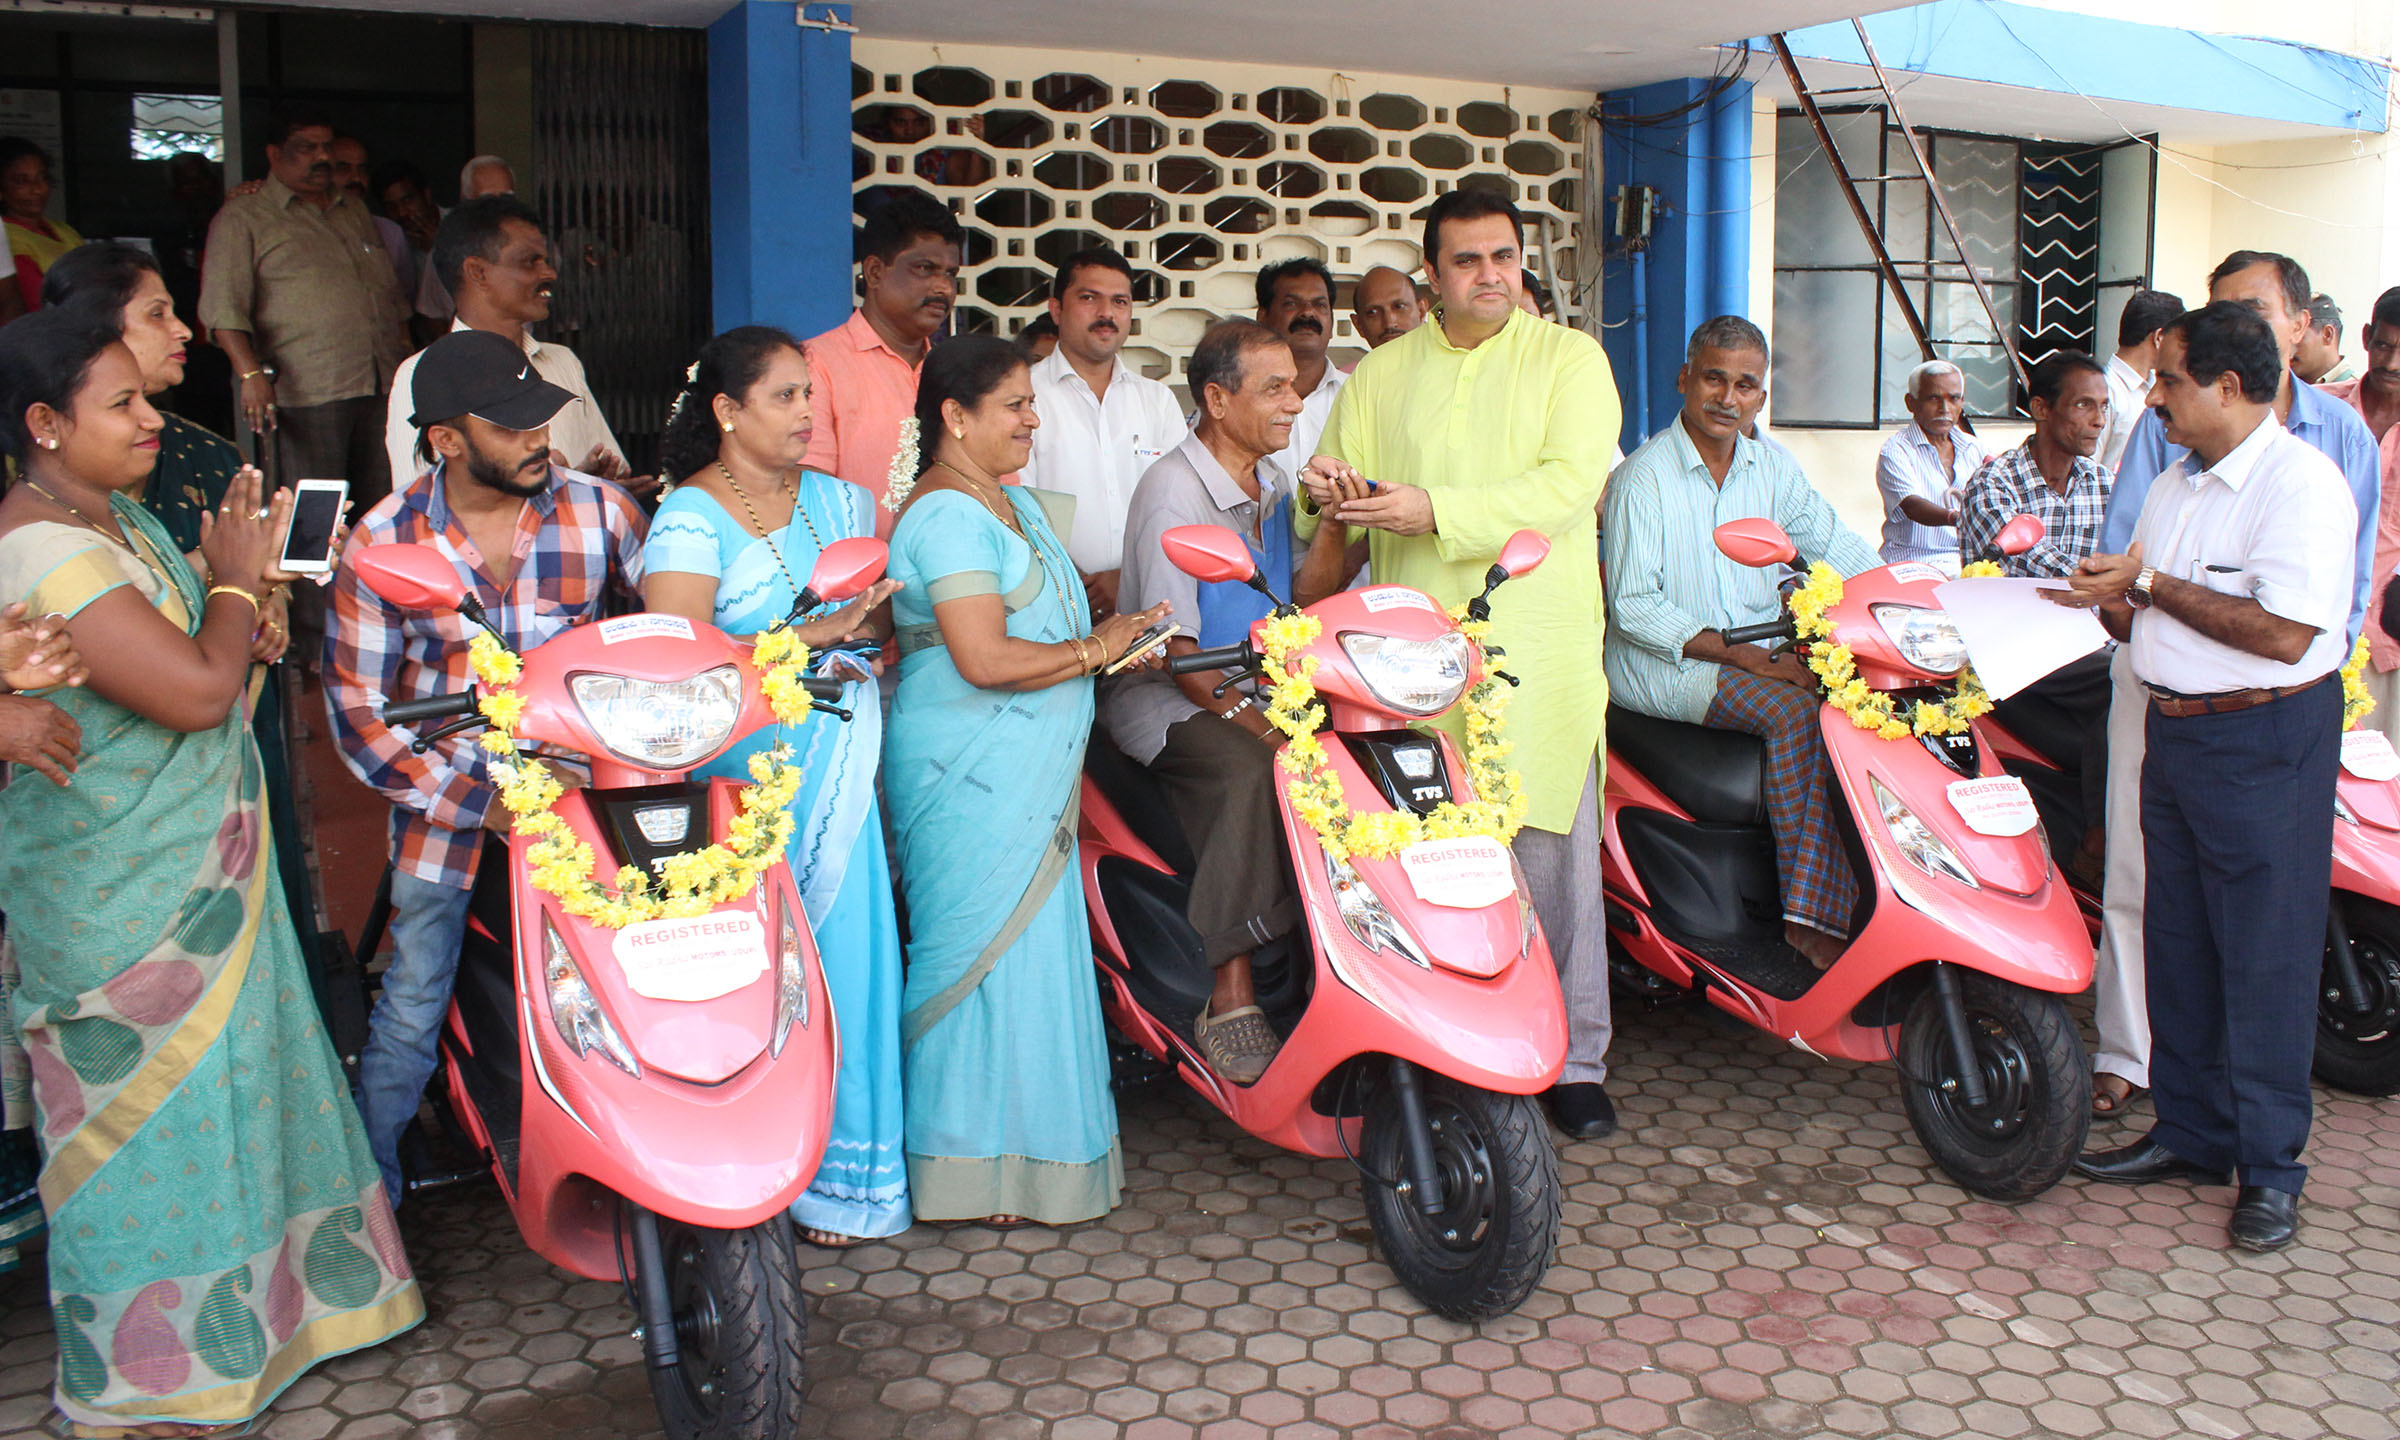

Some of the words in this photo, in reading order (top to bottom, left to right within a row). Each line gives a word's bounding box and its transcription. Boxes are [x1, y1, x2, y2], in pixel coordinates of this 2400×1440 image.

[1946, 736, 1971, 748] TVS
[1412, 786, 1444, 801] TVS
[1955, 783, 2020, 797] REGISTERED
[1410, 848, 1497, 865] REGISTERED
[630, 920, 751, 947] REGISTERED
[690, 950, 727, 960] MOTORS
